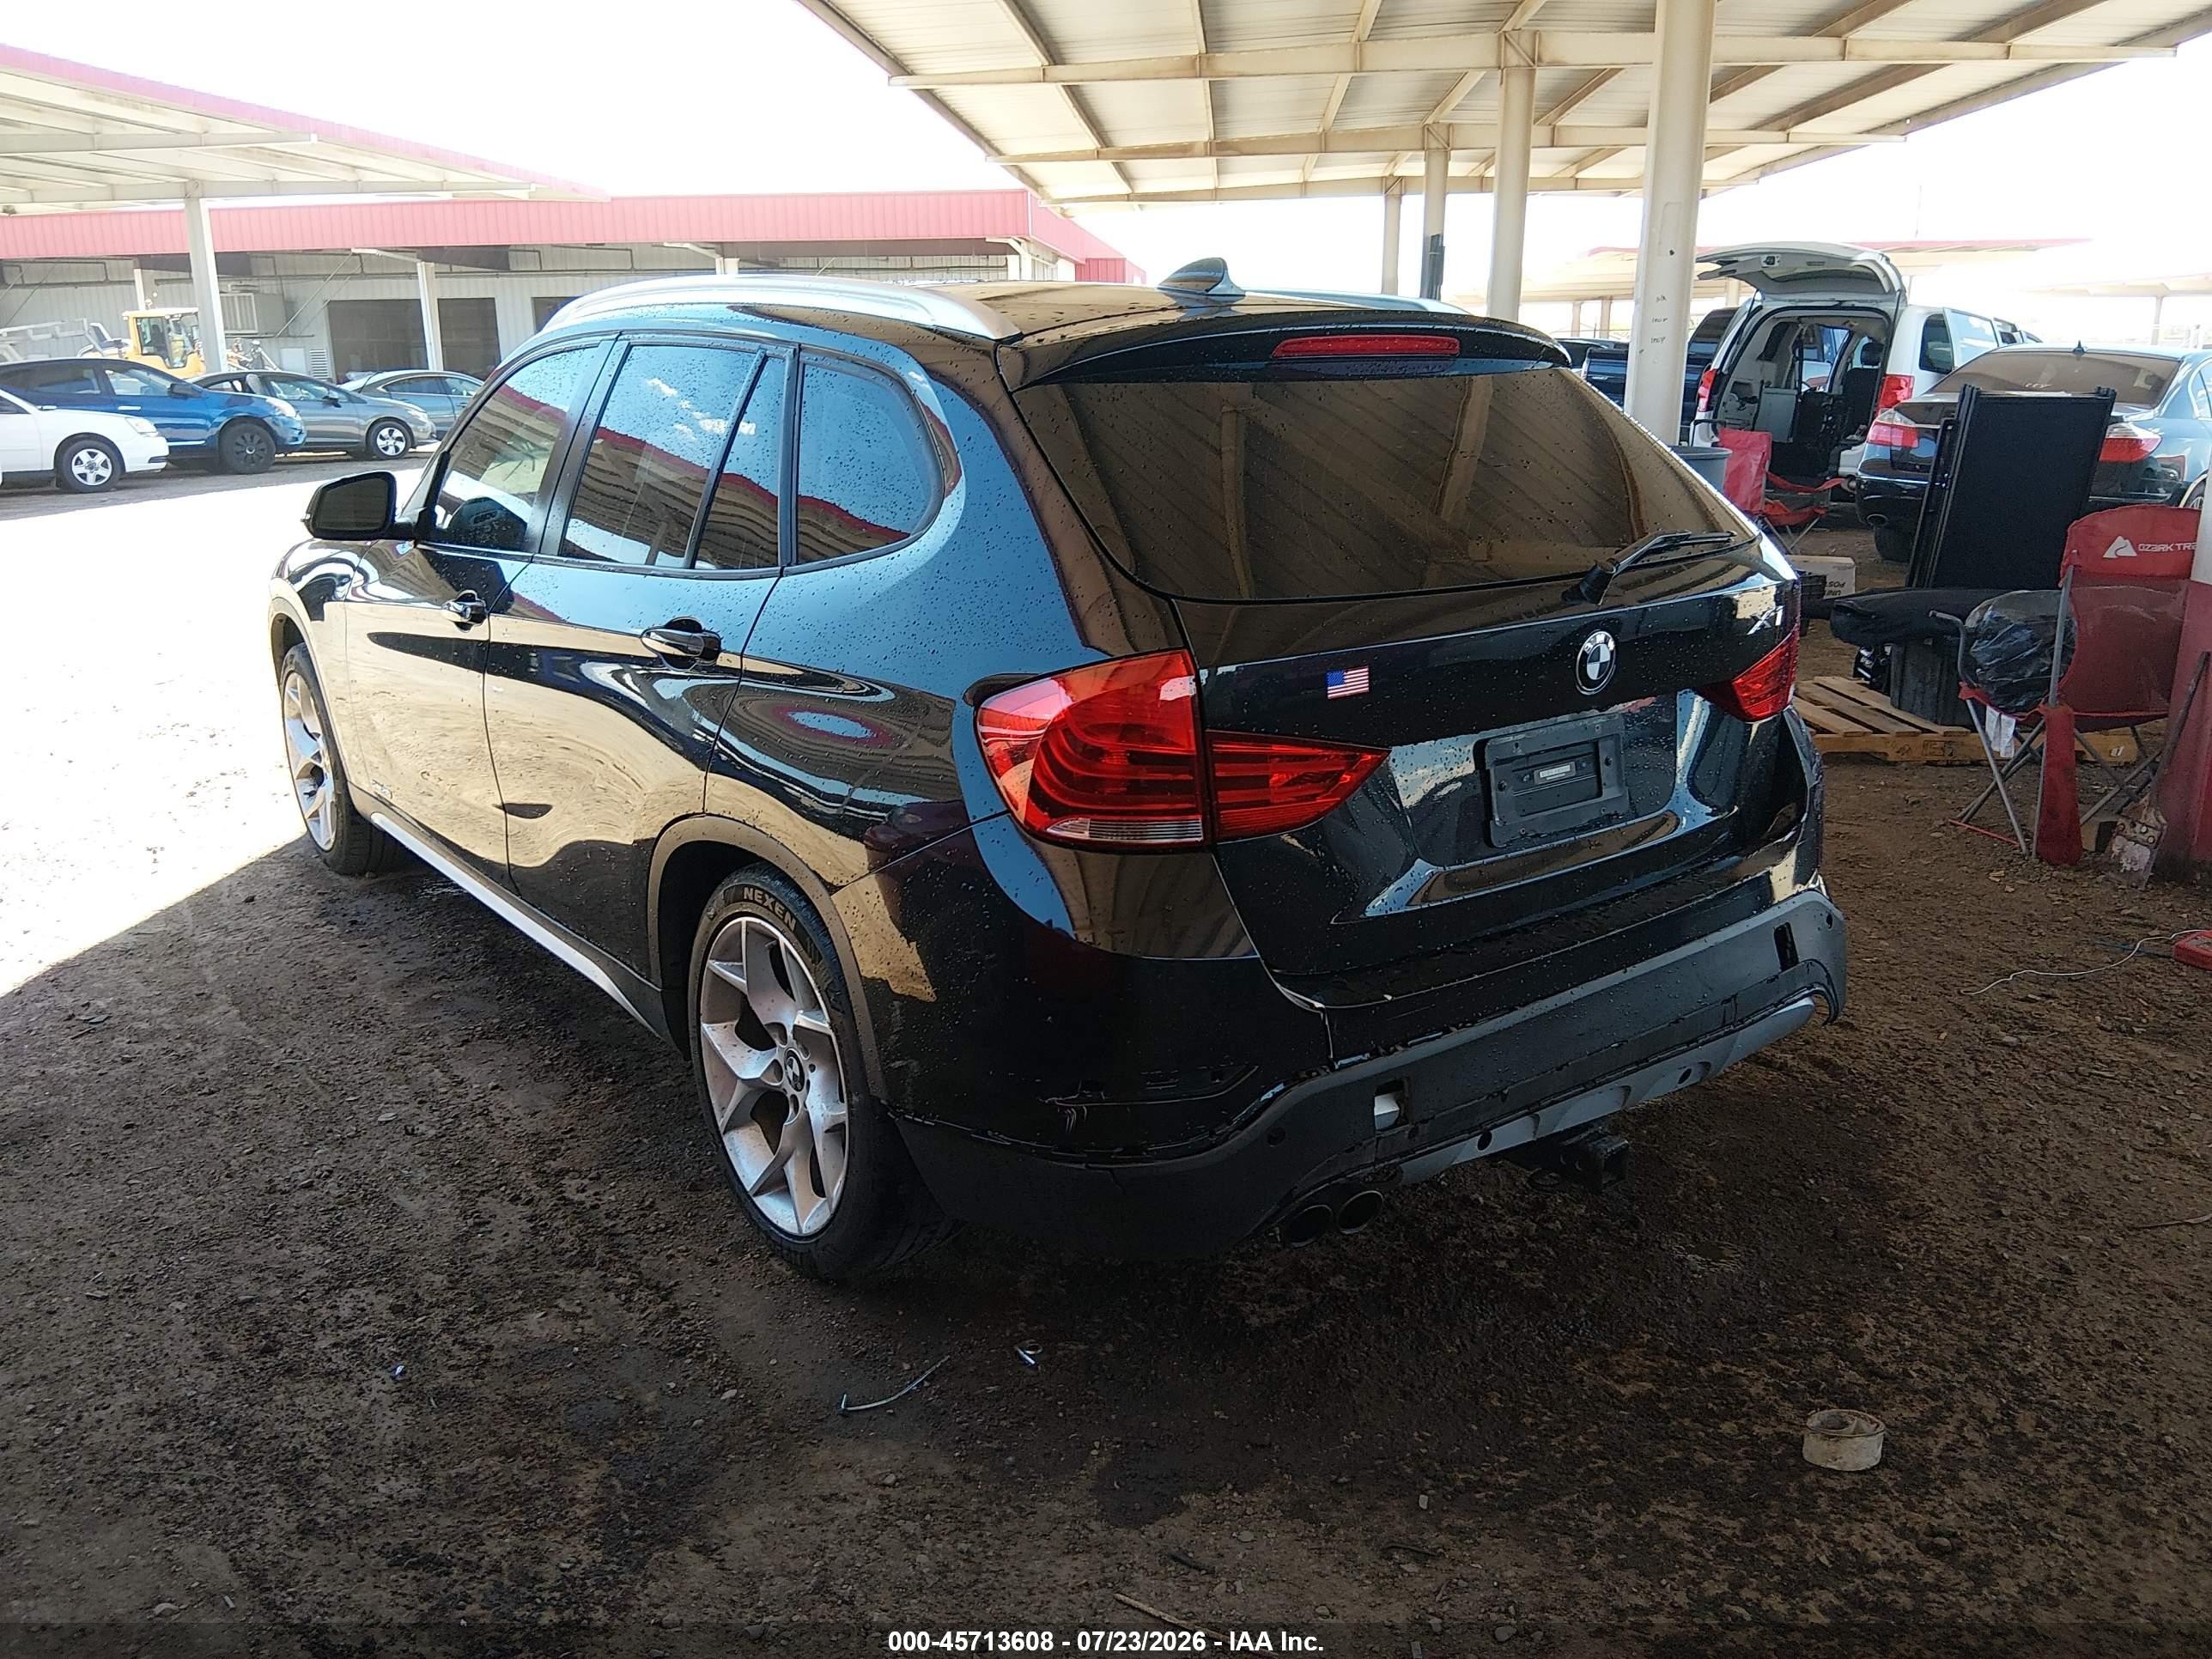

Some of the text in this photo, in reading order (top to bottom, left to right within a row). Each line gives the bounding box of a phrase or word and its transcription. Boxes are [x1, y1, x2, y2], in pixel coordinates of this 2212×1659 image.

[2138, 542, 2199, 552] OZARK TRA
[1747, 605, 1786, 635] X1
[1583, 634, 1615, 653] BMW
[743, 886, 798, 933] NEXEN
